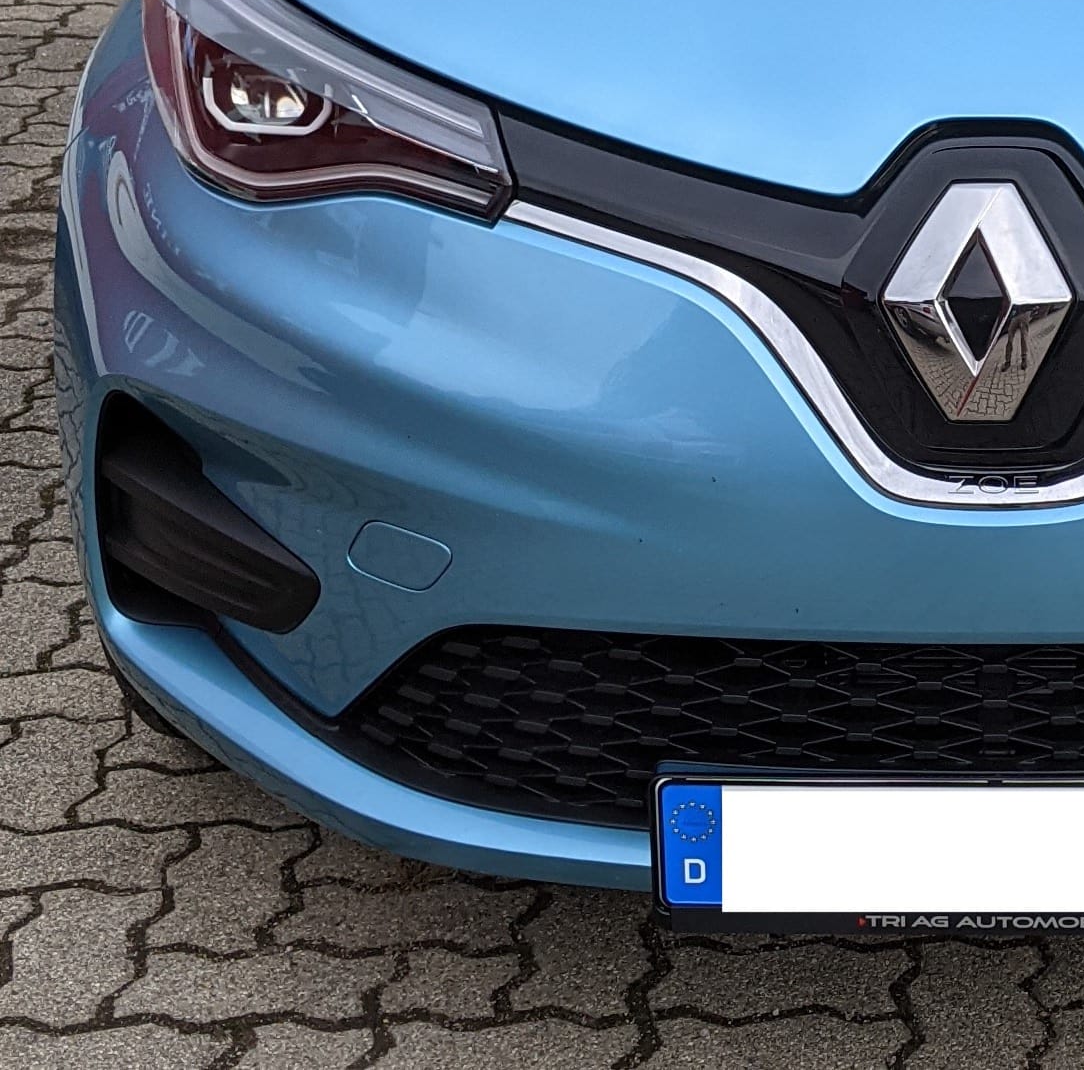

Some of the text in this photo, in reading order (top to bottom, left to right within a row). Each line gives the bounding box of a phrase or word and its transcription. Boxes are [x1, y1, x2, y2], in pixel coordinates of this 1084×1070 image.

[947, 475, 1039, 494] ZOE
[684, 858, 706, 884] D
[865, 915, 906, 928] TRI
[911, 915, 949, 928] AG
